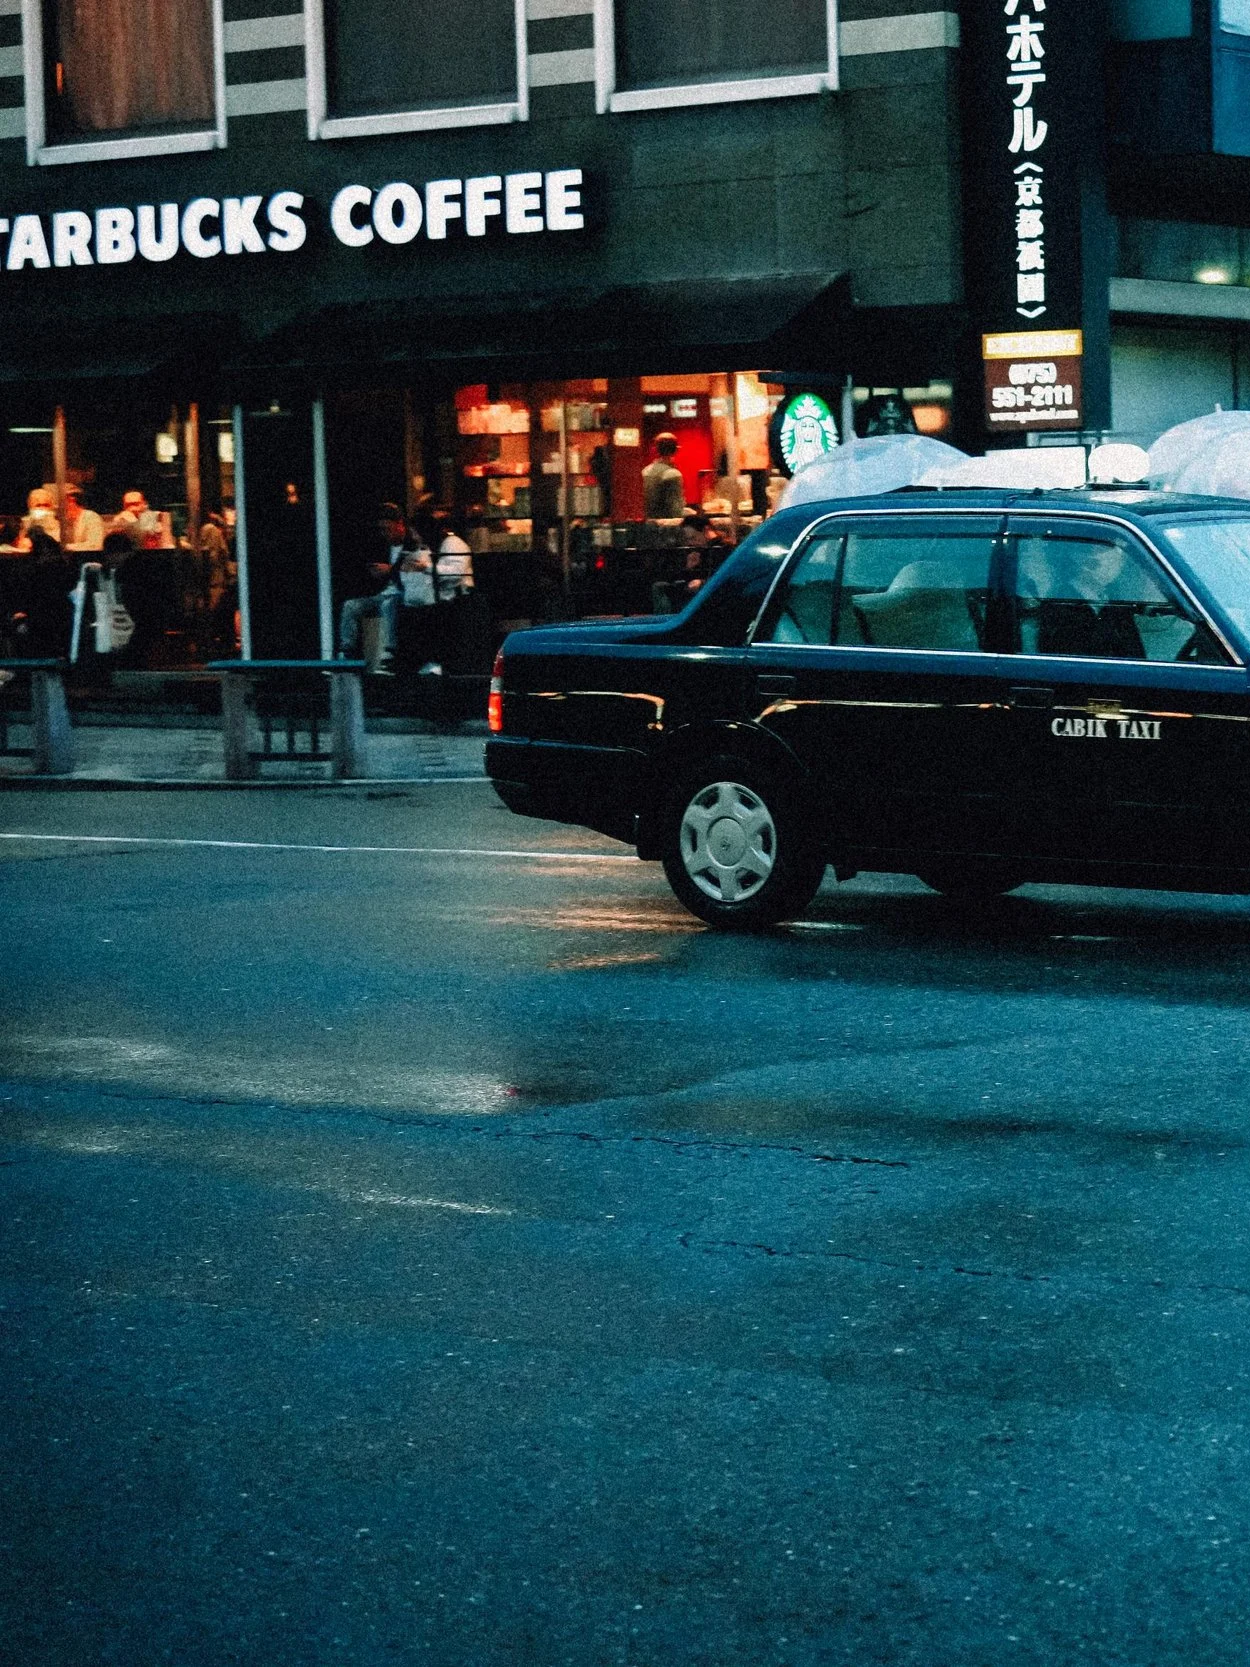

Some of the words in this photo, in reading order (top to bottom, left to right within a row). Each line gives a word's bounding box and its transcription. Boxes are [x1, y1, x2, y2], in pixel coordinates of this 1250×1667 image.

[331, 168, 585, 248] COFFEE
[1051, 717, 1108, 738] CABIK
[1117, 719, 1162, 740] TAXI
